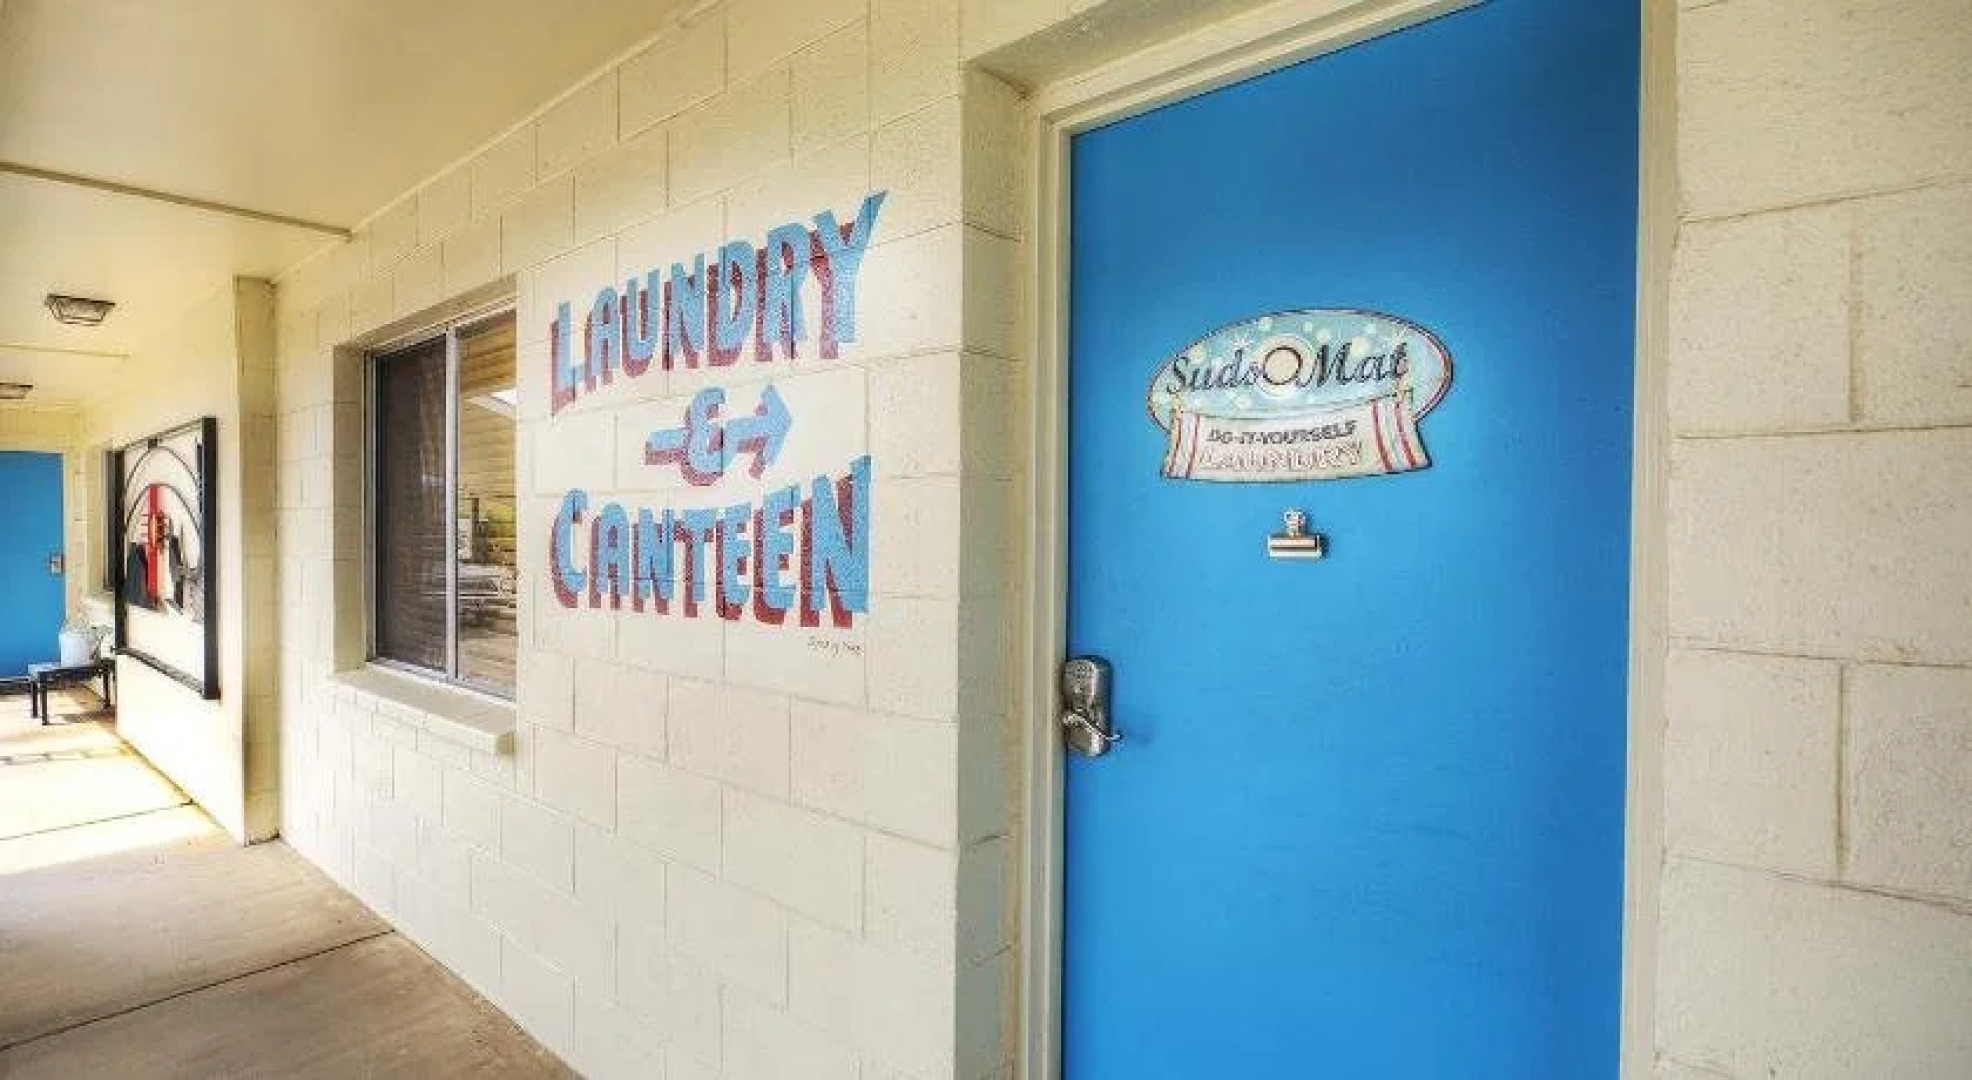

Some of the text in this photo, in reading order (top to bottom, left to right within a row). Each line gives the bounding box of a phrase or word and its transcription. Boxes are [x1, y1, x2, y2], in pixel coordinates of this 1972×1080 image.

[551, 189, 888, 416] LAUNDRY
[1167, 350, 1263, 395] Suds
[1298, 343, 1408, 388] Mat
[683, 386, 726, 486] &
[1199, 442, 1362, 471] LAUNDRY
[1207, 420, 1357, 445] DO-IT-YOURSELF
[551, 455, 871, 629] CANTEEN
